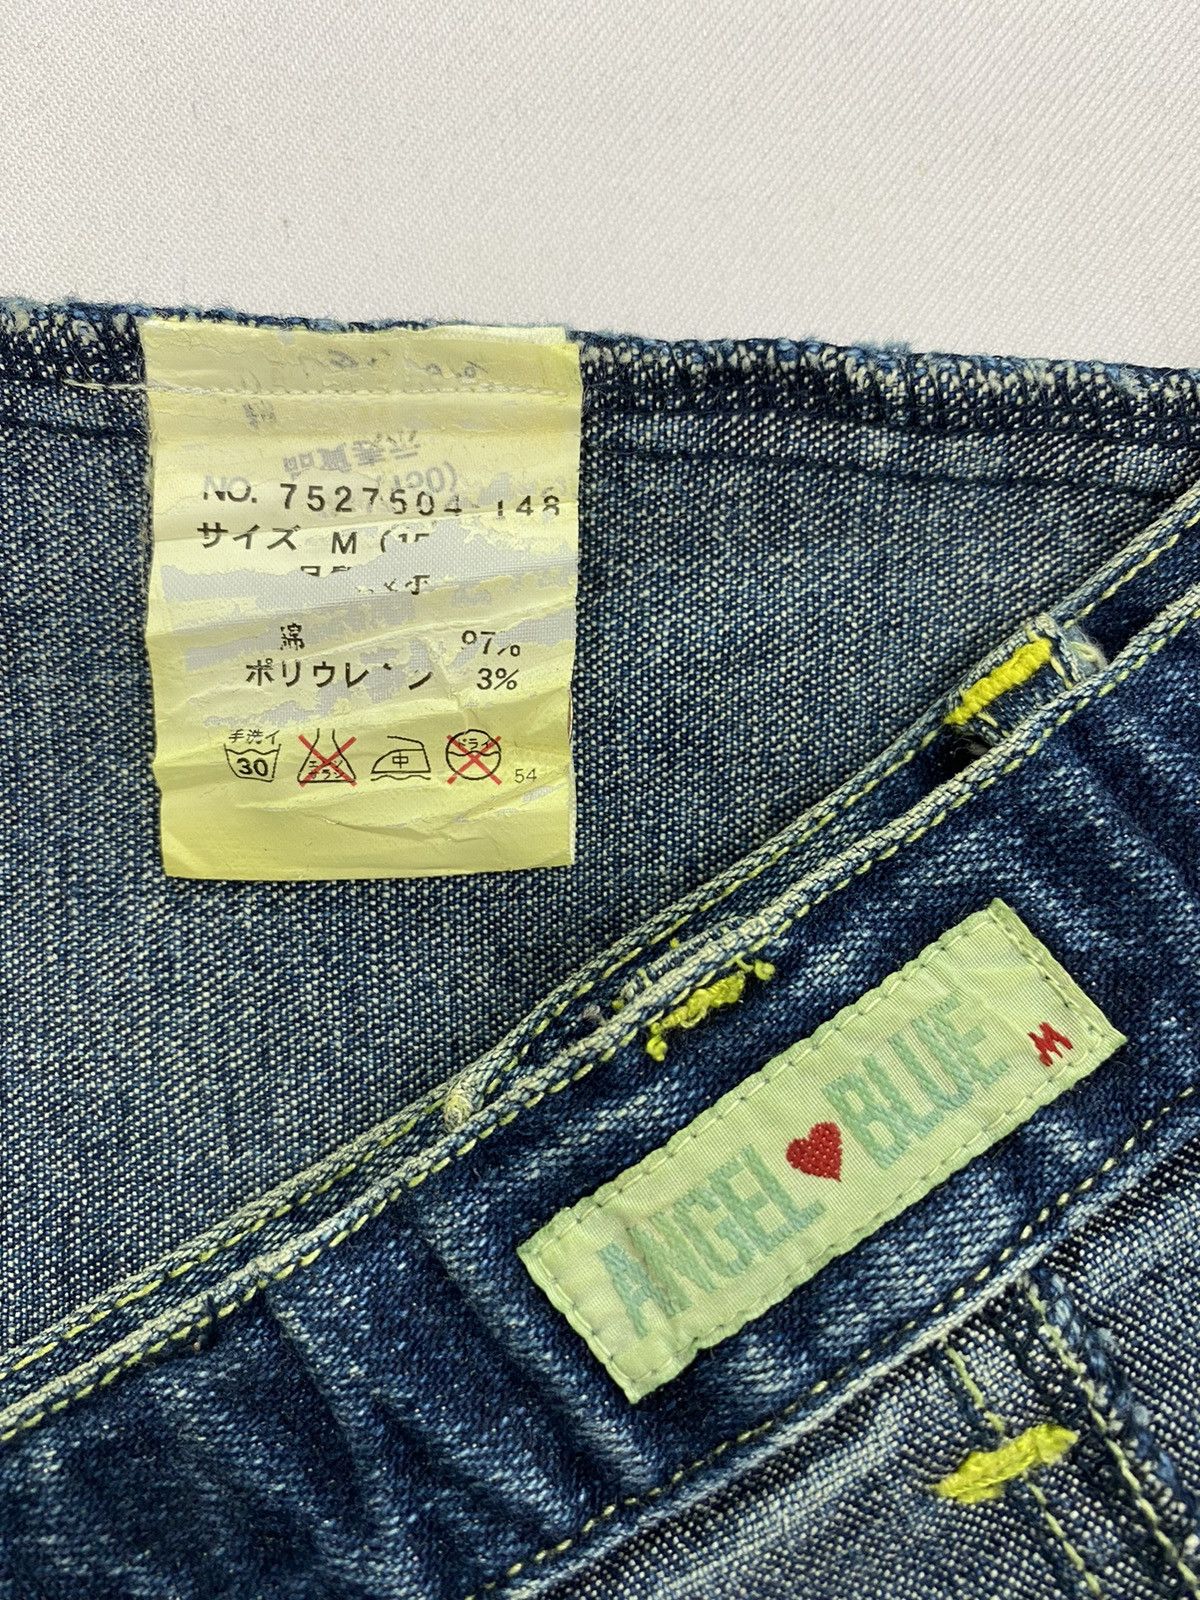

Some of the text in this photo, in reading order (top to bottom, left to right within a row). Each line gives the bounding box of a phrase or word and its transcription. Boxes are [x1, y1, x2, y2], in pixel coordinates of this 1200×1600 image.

[197, 522, 301, 551] サイズ
[331, 531, 358, 555] M
[245, 658, 519, 692] ポリウレン 3%
[236, 757, 269, 777] 30
[513, 768, 538, 784] 54
[1027, 1021, 1074, 1067] M
[597, 994, 1010, 1340] ANGEL BLUE
